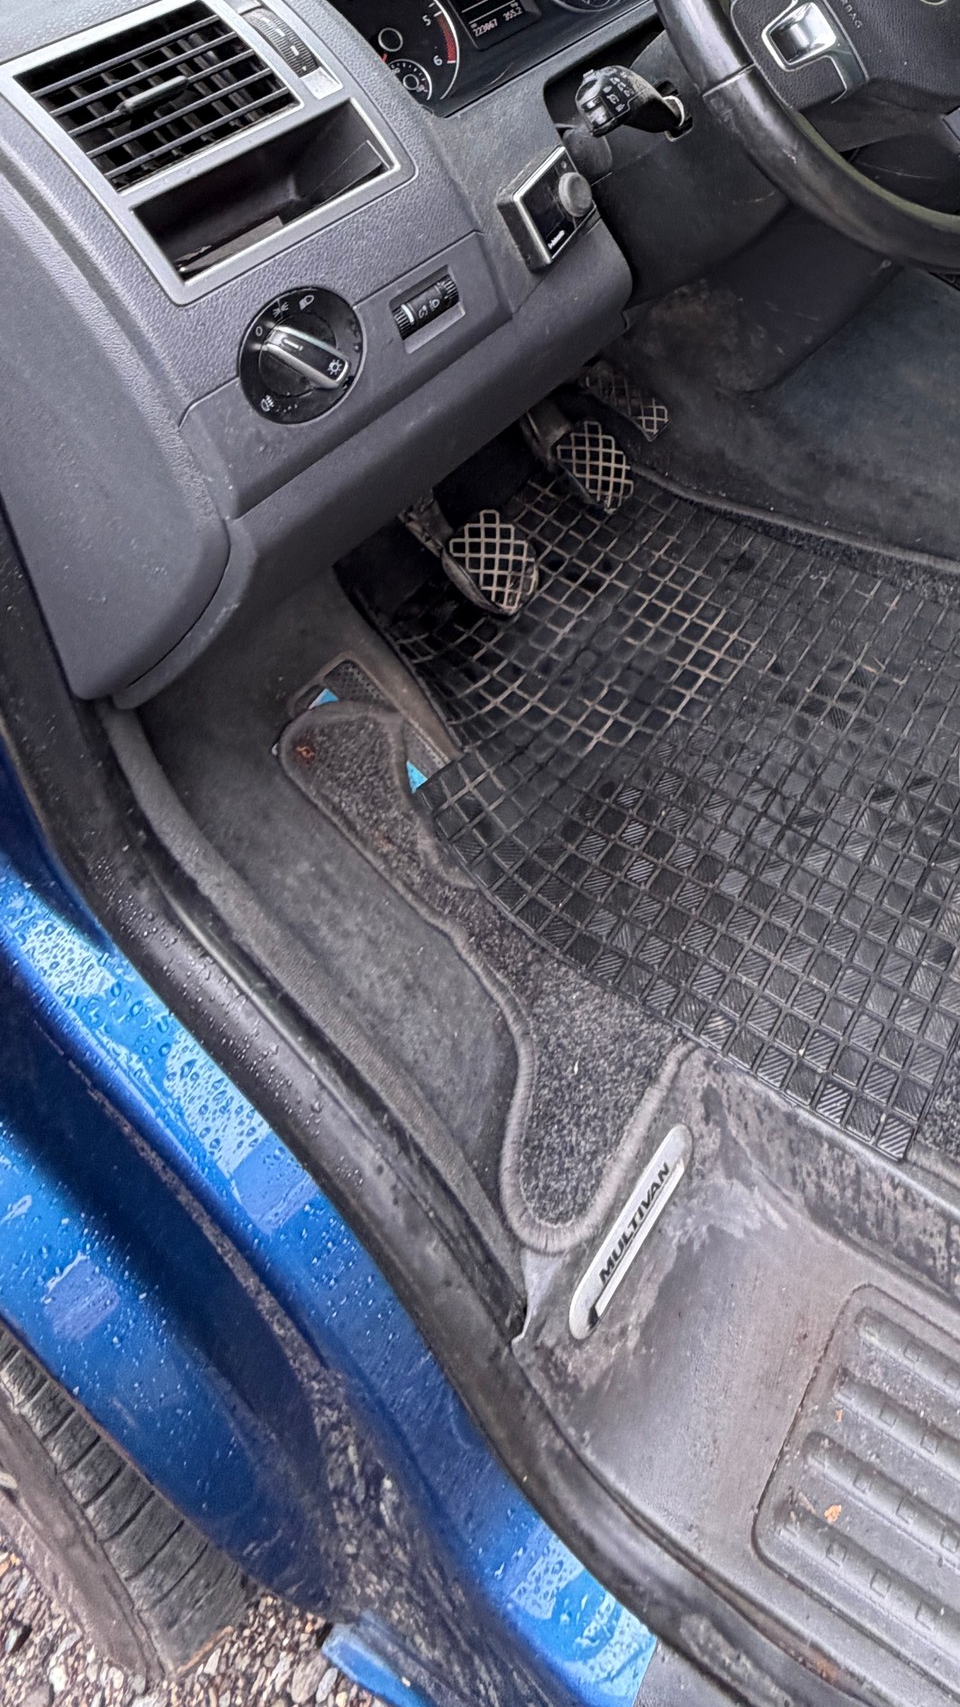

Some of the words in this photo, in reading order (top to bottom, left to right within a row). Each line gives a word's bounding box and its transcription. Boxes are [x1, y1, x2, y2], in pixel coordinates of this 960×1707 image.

[422, 15, 432, 26] 5
[433, 55, 443, 66] 6
[599, 1162, 670, 1284] MULTIVAN
